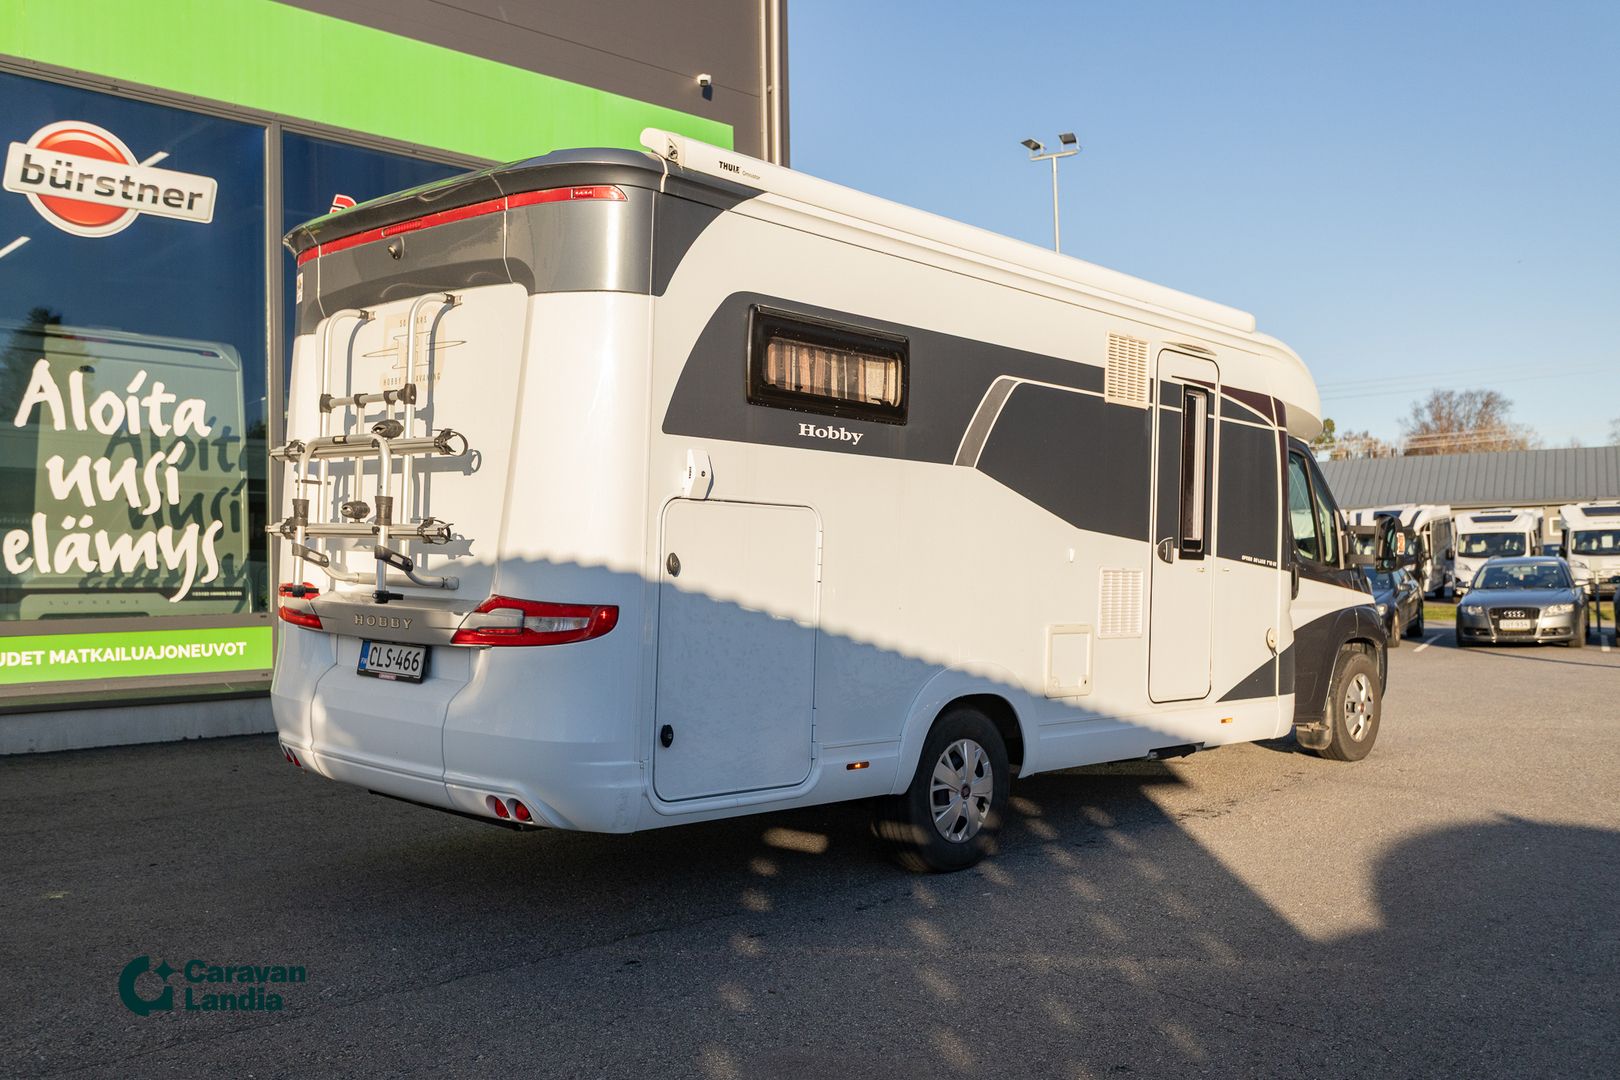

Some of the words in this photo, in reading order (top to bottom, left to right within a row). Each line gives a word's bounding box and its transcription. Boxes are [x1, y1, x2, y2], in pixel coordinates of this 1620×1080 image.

[718, 160, 740, 174] THULE
[20, 153, 203, 210] bürstner
[798, 422, 864, 445] Hobby
[2, 511, 223, 603] elämys
[354, 614, 413, 629] HOBBY
[49, 641, 248, 665] MATKAILUAJONEUVOT
[368, 646, 421, 672] CLS-466
